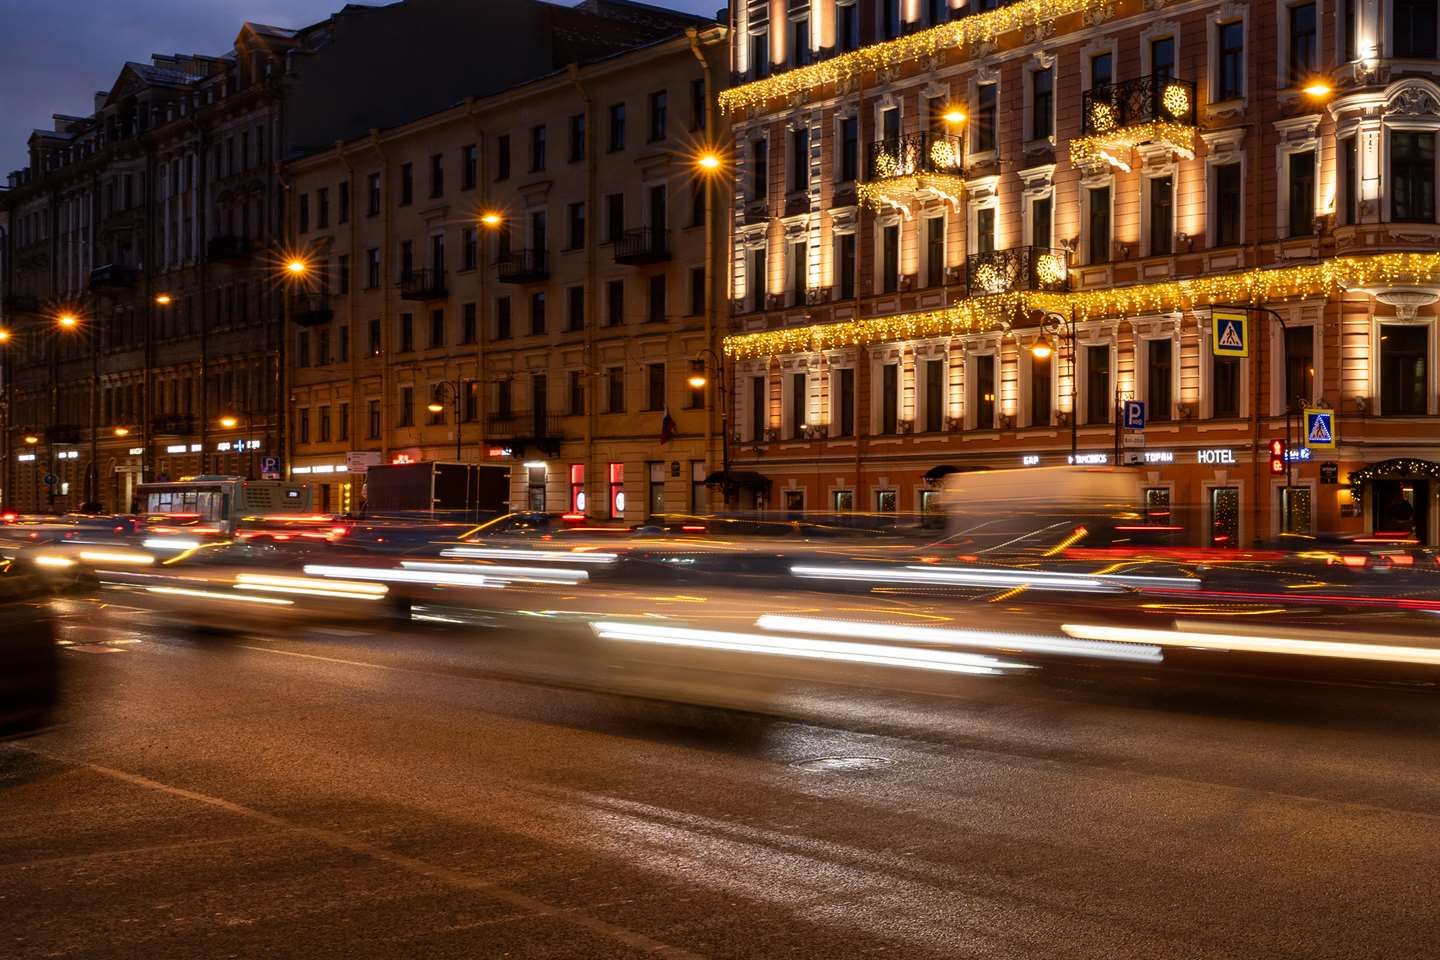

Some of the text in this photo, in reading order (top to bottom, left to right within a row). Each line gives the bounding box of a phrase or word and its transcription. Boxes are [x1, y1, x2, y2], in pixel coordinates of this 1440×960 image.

[1129, 404, 1141, 425] P
[1023, 456, 1039, 465] БАР
[1144, 452, 1173, 462] ТОРАН
[1198, 449, 1235, 464] HOTEL
